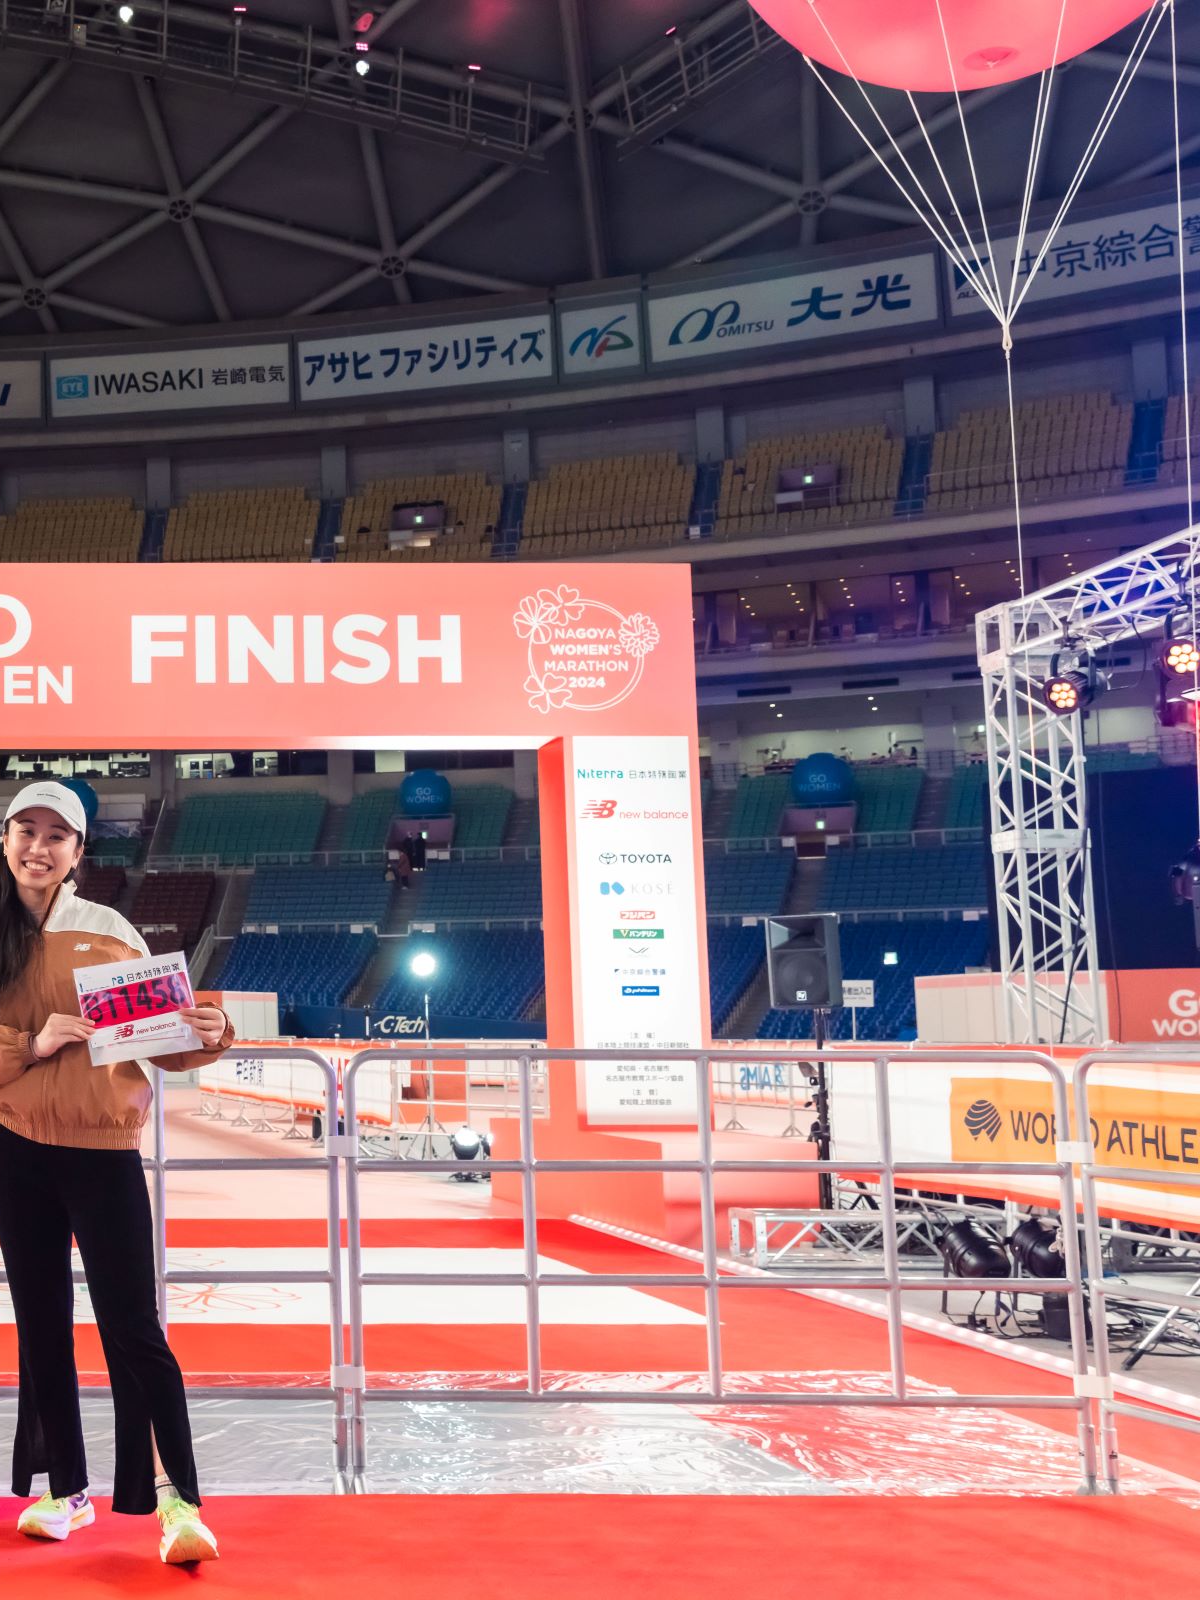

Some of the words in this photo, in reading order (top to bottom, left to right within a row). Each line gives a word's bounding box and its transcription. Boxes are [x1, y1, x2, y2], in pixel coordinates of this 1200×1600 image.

[716, 319, 775, 338] OMITSU
[786, 273, 912, 328] 大光
[94, 368, 204, 396] IWASAKI
[211, 364, 286, 387] 岩崎電気
[554, 628, 616, 639] NAGOYA
[131, 613, 462, 685] FINISH
[550, 644, 622, 656] WOMEN'S
[544, 660, 629, 672] MARATHON
[568, 677, 606, 688] 2024
[577, 768, 624, 779] Niterra
[809, 774, 826, 782] GO
[415, 787, 432, 795] GO
[798, 782, 841, 792] WOMEN
[405, 795, 444, 803] WOMEN
[619, 811, 641, 819] new
[643, 810, 689, 819] balance
[620, 854, 672, 863] TOYOTA
[1168, 989, 1200, 1017] G
[150, 1021, 177, 1032] balance
[1106, 1120, 1199, 1164] ATHLE
